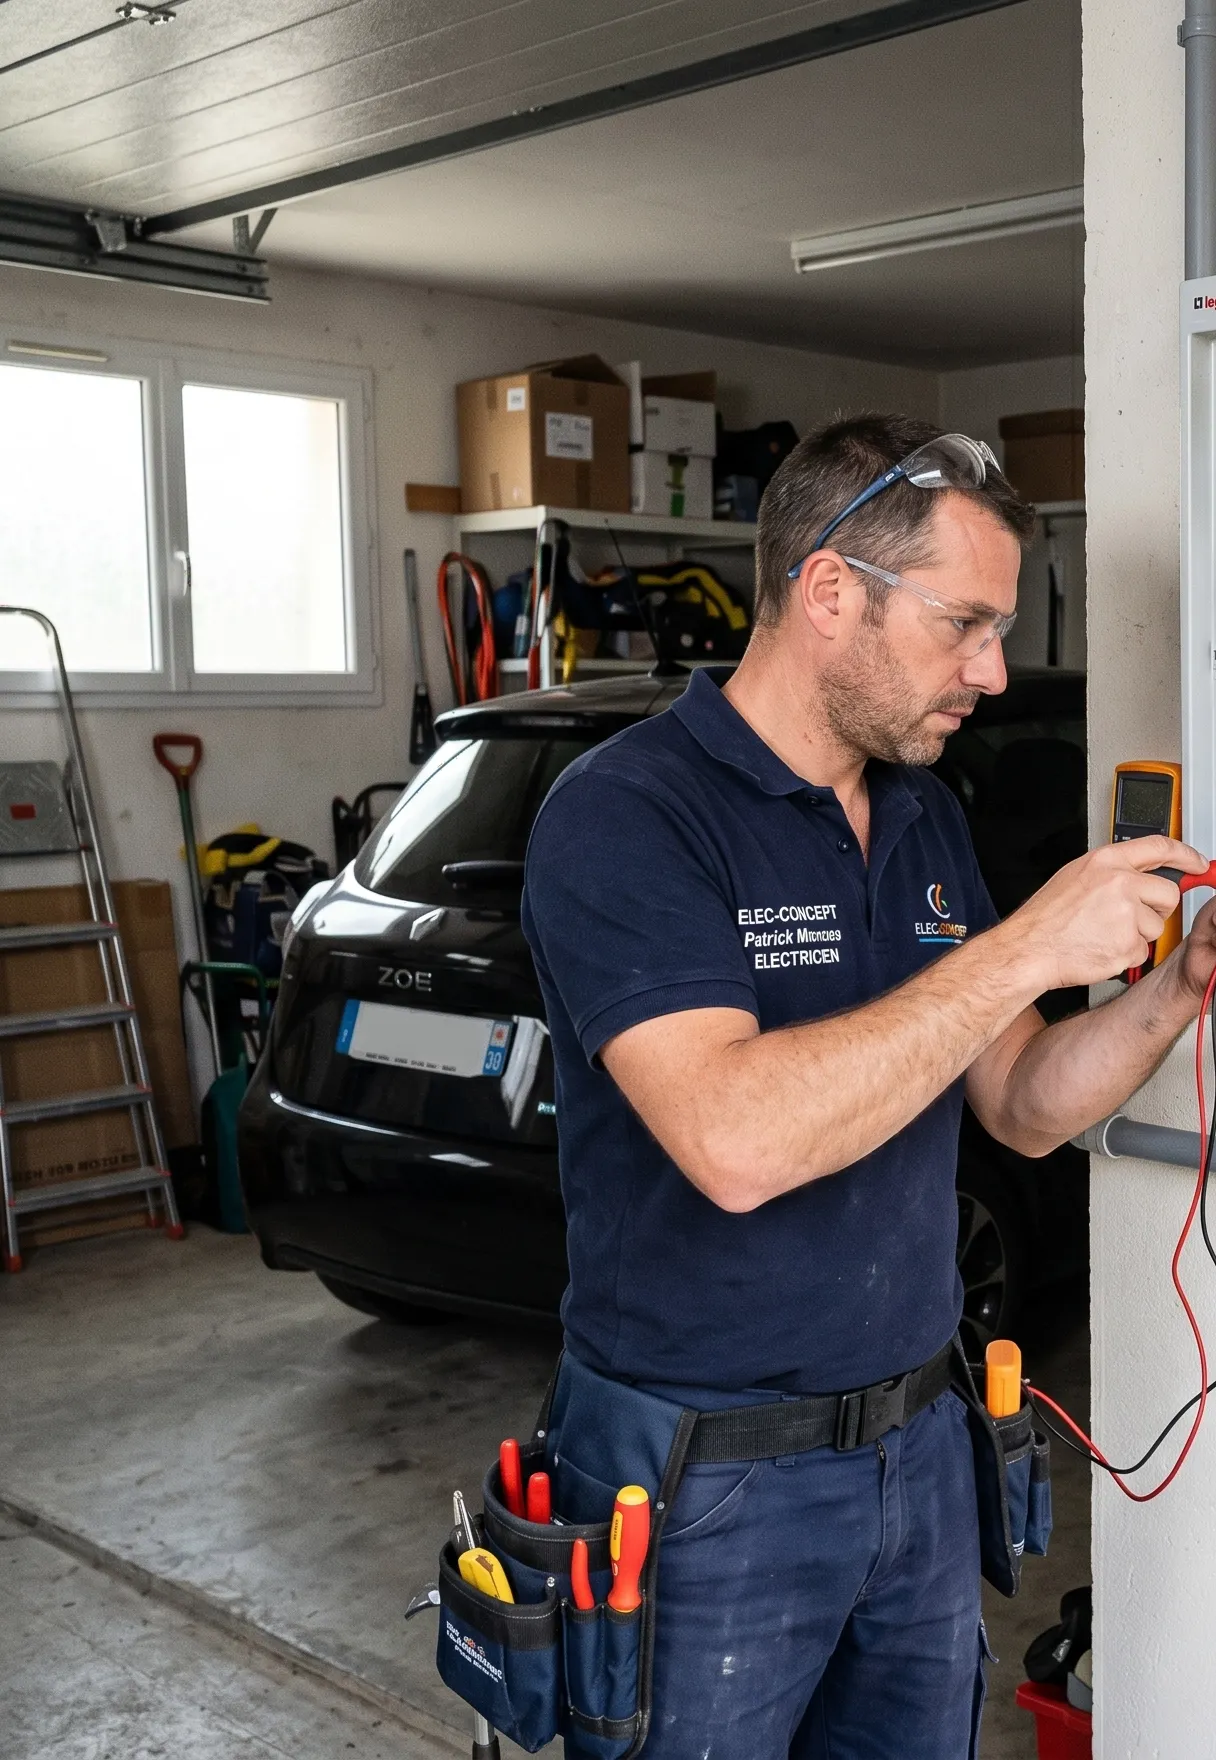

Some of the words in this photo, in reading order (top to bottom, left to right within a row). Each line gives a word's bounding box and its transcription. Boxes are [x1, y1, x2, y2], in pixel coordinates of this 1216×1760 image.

[738, 904, 837, 925] ELEC-CONCEPT
[744, 929, 794, 948] Patrick
[378, 965, 433, 993] ZOE
